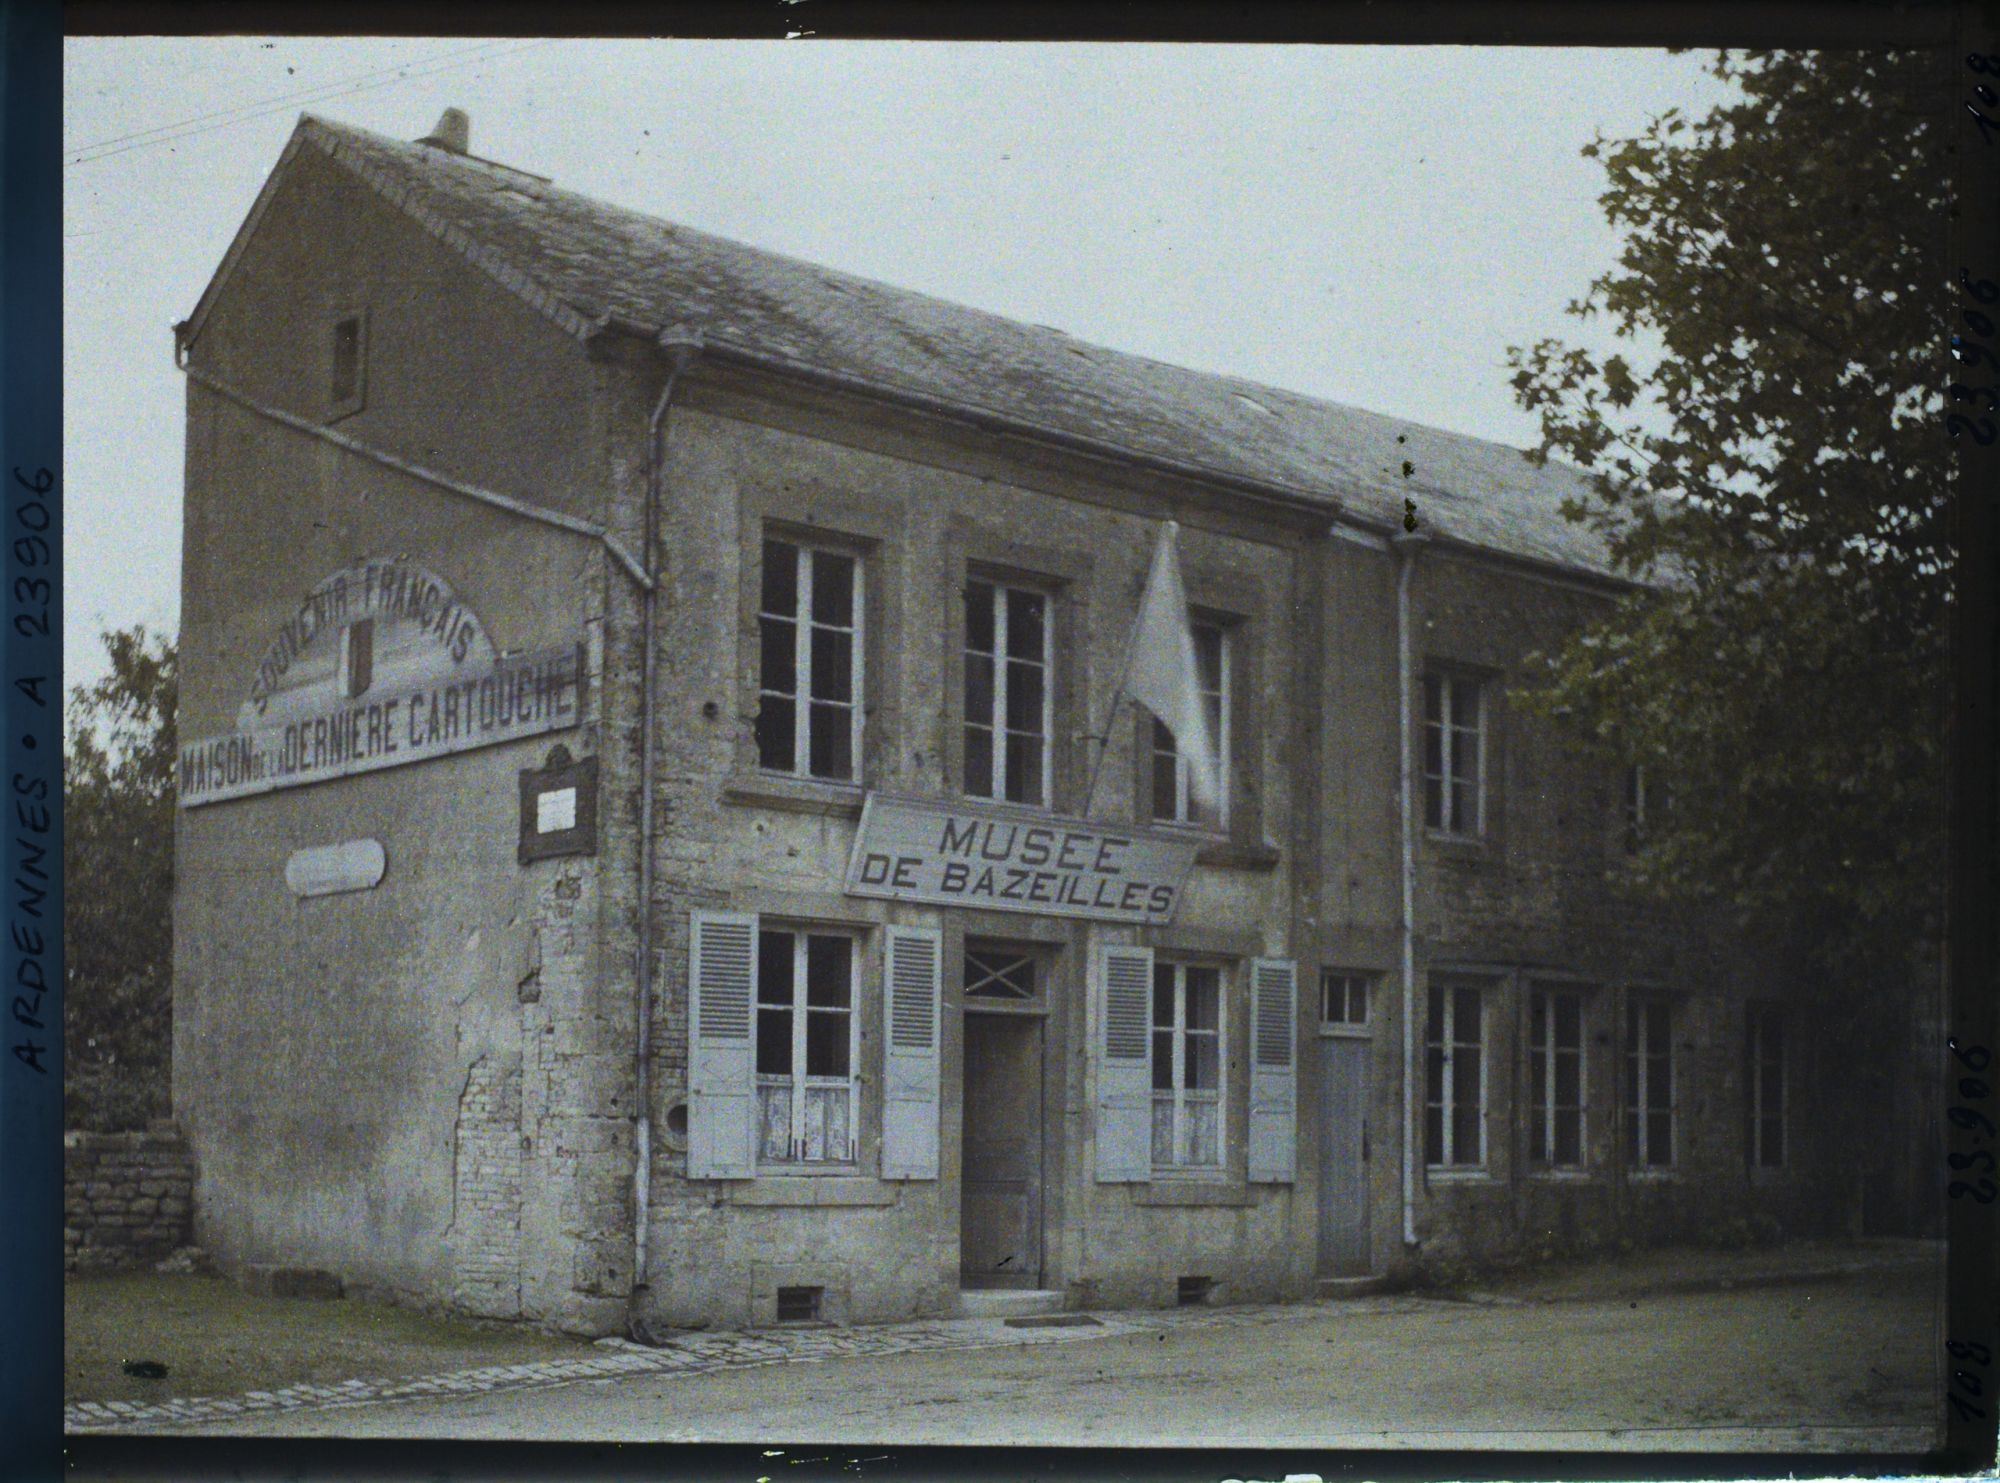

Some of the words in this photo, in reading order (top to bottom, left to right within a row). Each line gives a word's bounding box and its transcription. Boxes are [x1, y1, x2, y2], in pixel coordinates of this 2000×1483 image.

[12, 465, 54, 638] 23906
[13, 676, 48, 708] A
[181, 735, 254, 795] MAISON
[408, 652, 574, 747] CARTOUCHE
[860, 852, 923, 888] DE
[940, 862, 1175, 913] BAZEILLES
[939, 817, 1130, 875] MUSEE
[10, 773, 51, 1075] ARDENNES
[1945, 1339, 1992, 1424] 108
